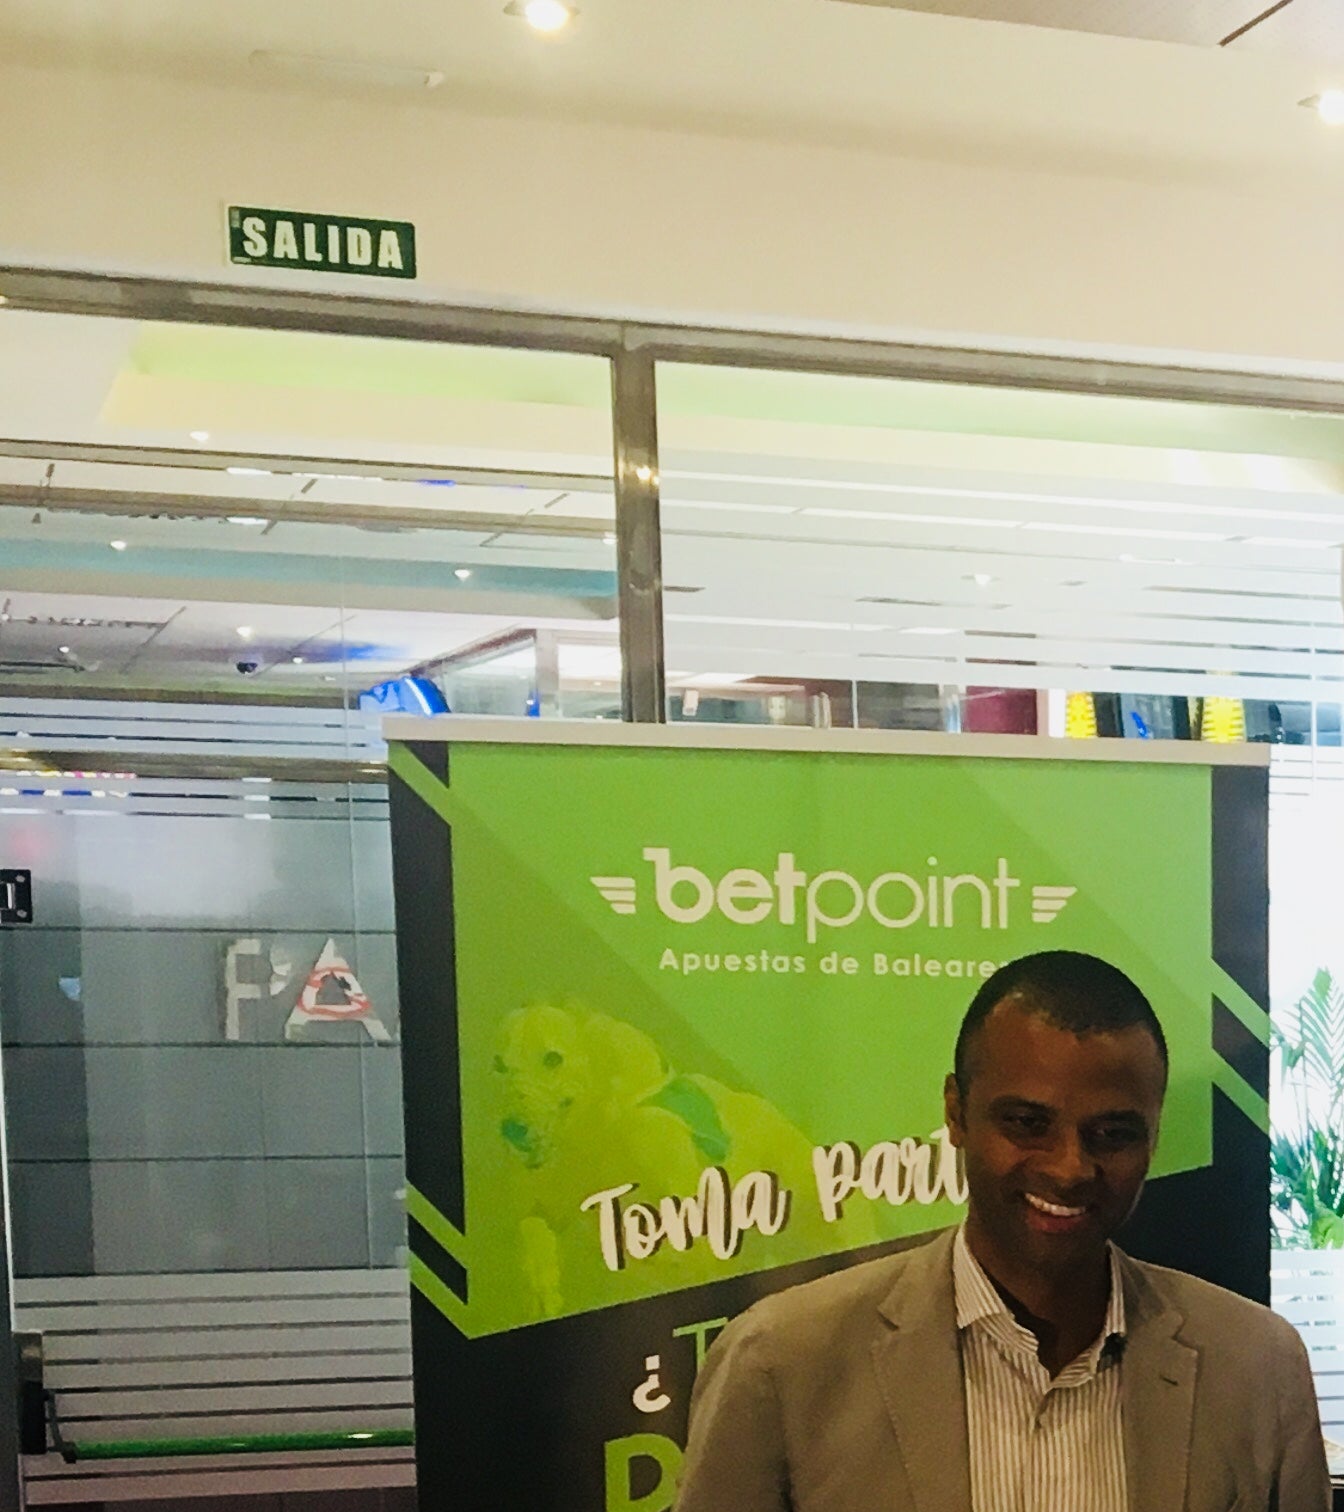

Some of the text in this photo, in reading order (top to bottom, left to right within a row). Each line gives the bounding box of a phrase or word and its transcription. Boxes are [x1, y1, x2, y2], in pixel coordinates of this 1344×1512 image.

[242, 217, 403, 269] SALIDA
[643, 847, 1019, 943] betpoint
[659, 949, 1004, 978] Apuestas de Baleare
[581, 1125, 969, 1271] Toma part
